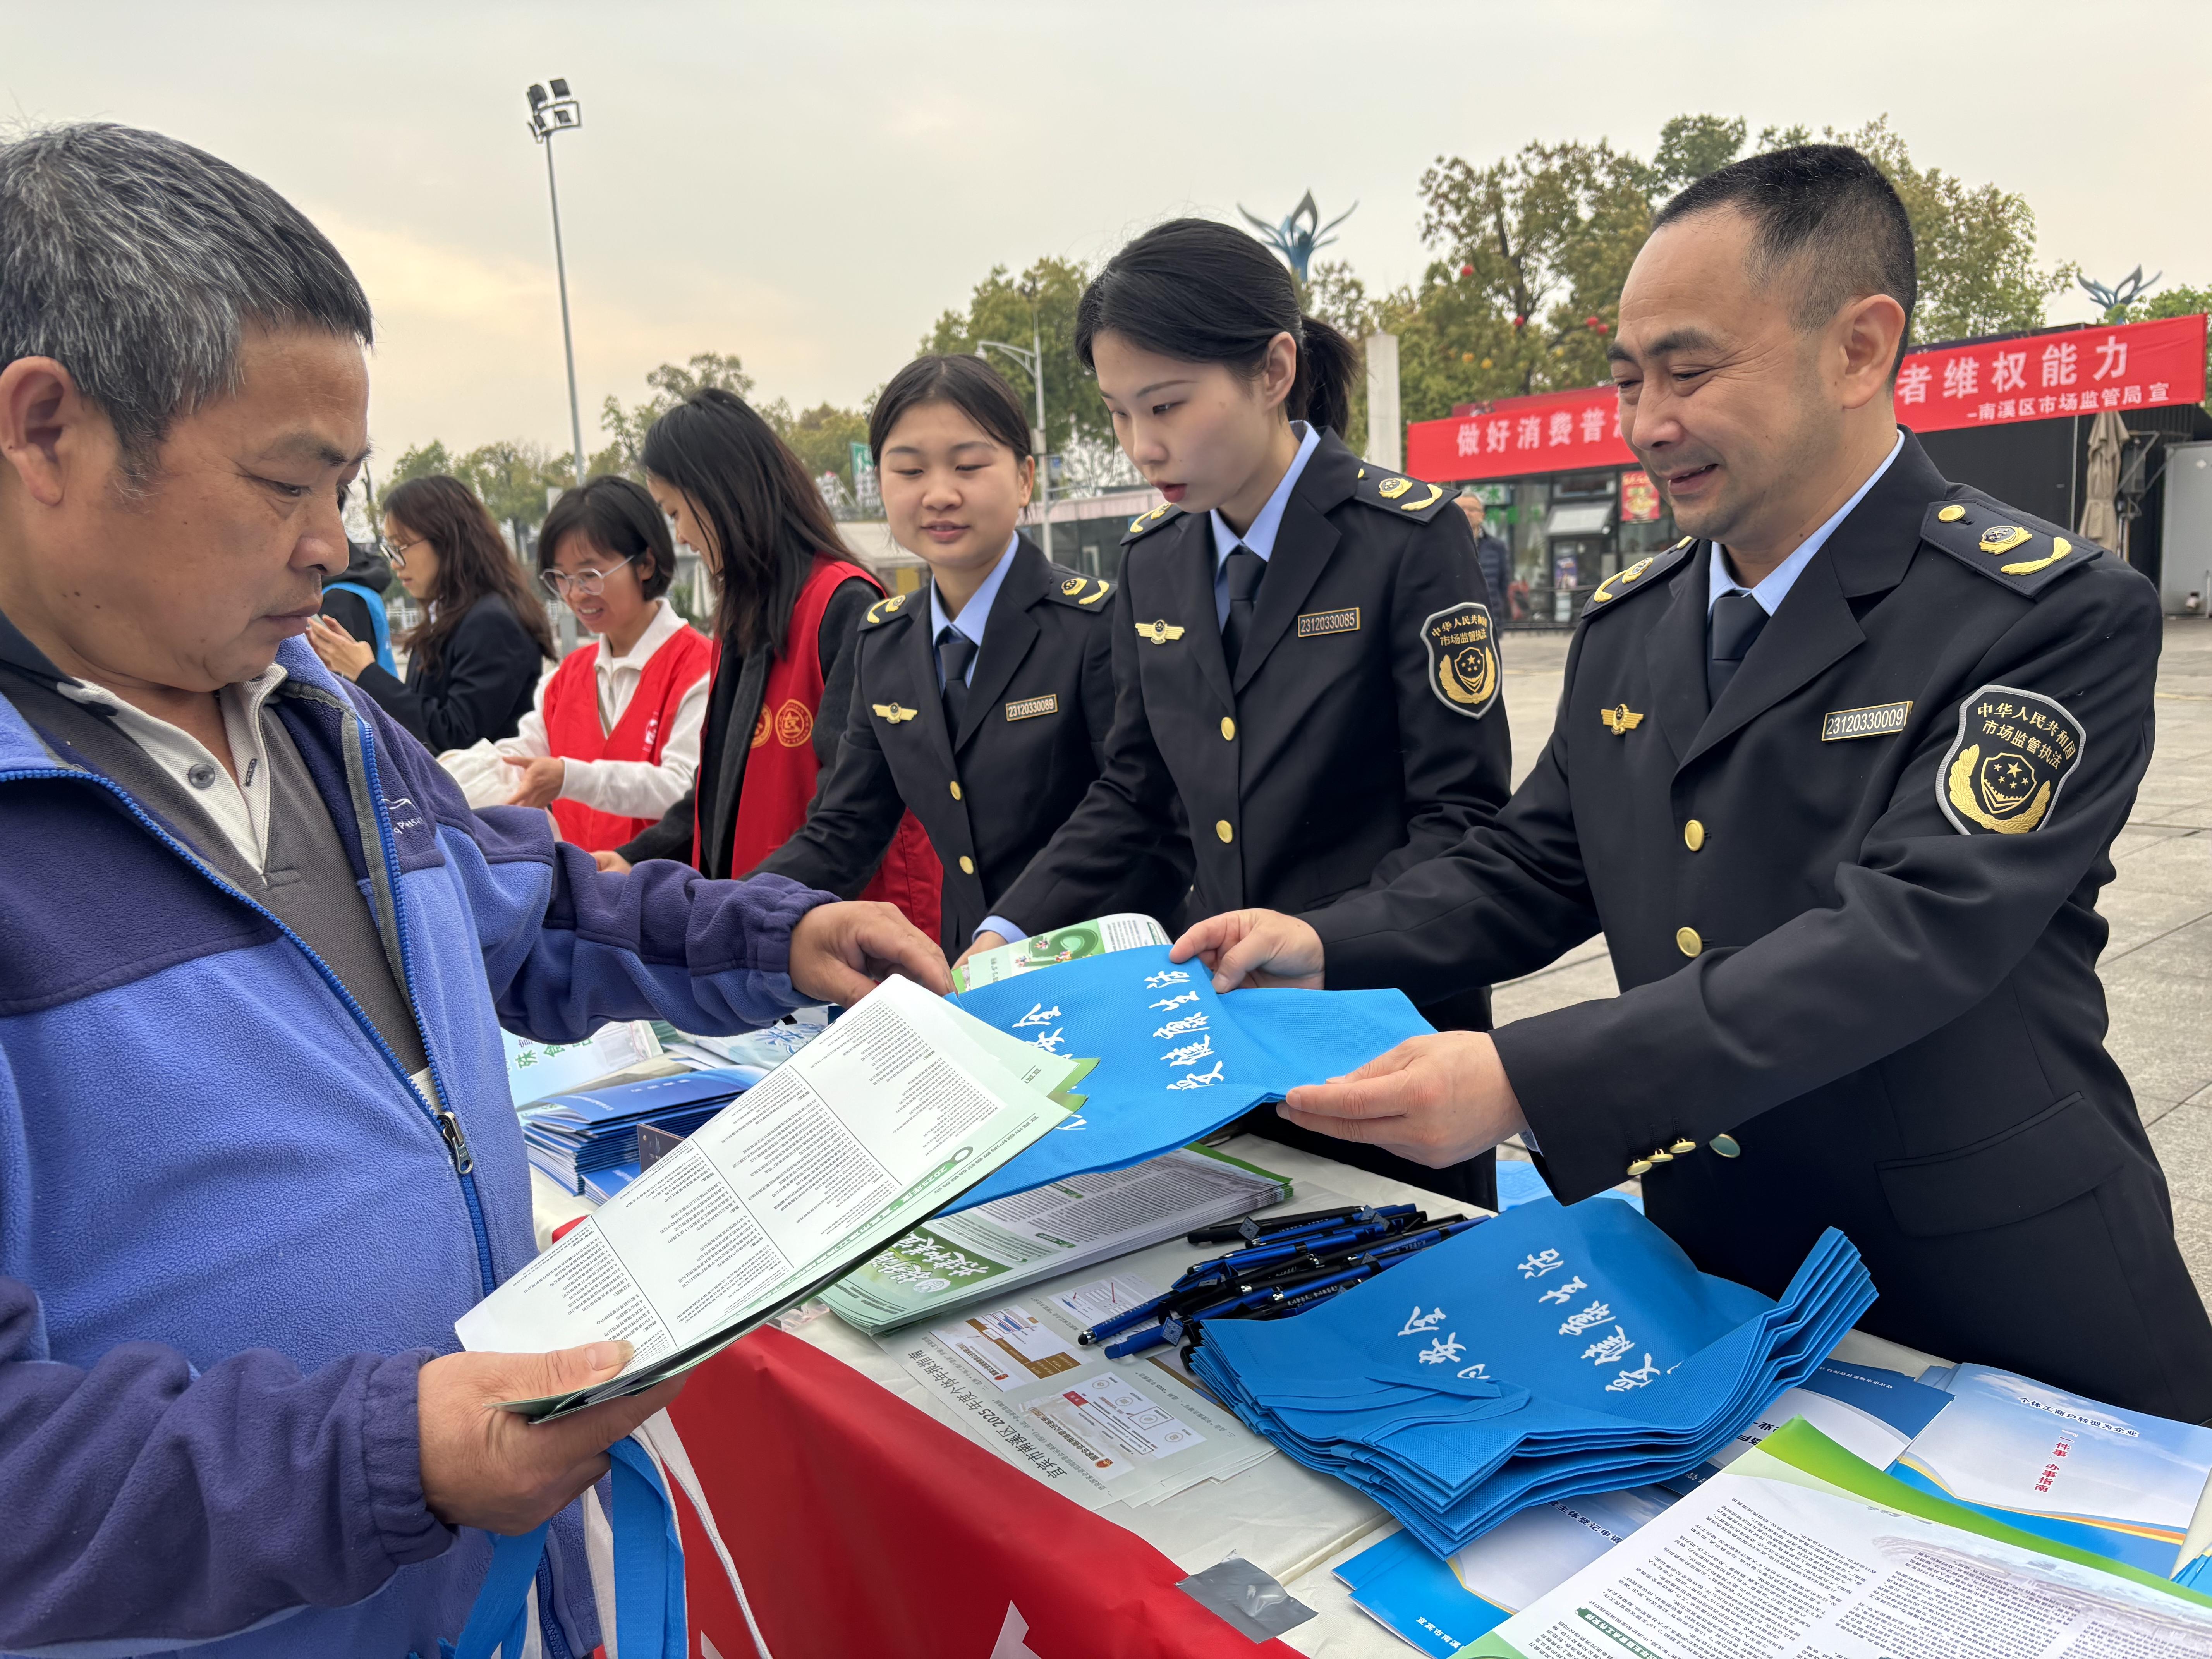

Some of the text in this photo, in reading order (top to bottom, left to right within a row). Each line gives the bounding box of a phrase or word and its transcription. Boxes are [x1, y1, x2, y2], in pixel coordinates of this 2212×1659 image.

[1898, 335, 2128, 404] 者维权能力
[1457, 407, 1622, 457] 做好消费普
[1301, 613, 1355, 633] 23120330085
[1008, 698, 1054, 717] 23120330089
[1826, 708, 1903, 735] 23120330009
[1977, 702, 2076, 761] 中华人民共和国
[1982, 720, 2063, 771] 市场监管执法
[907, 1348, 985, 1411] 年度个体年报指南
[979, 1407, 1005, 1426] 2025
[2018, 1396, 2139, 1437] 个体工商户转型为企业
[995, 1424, 1067, 1480] 宜宾市南溪区
